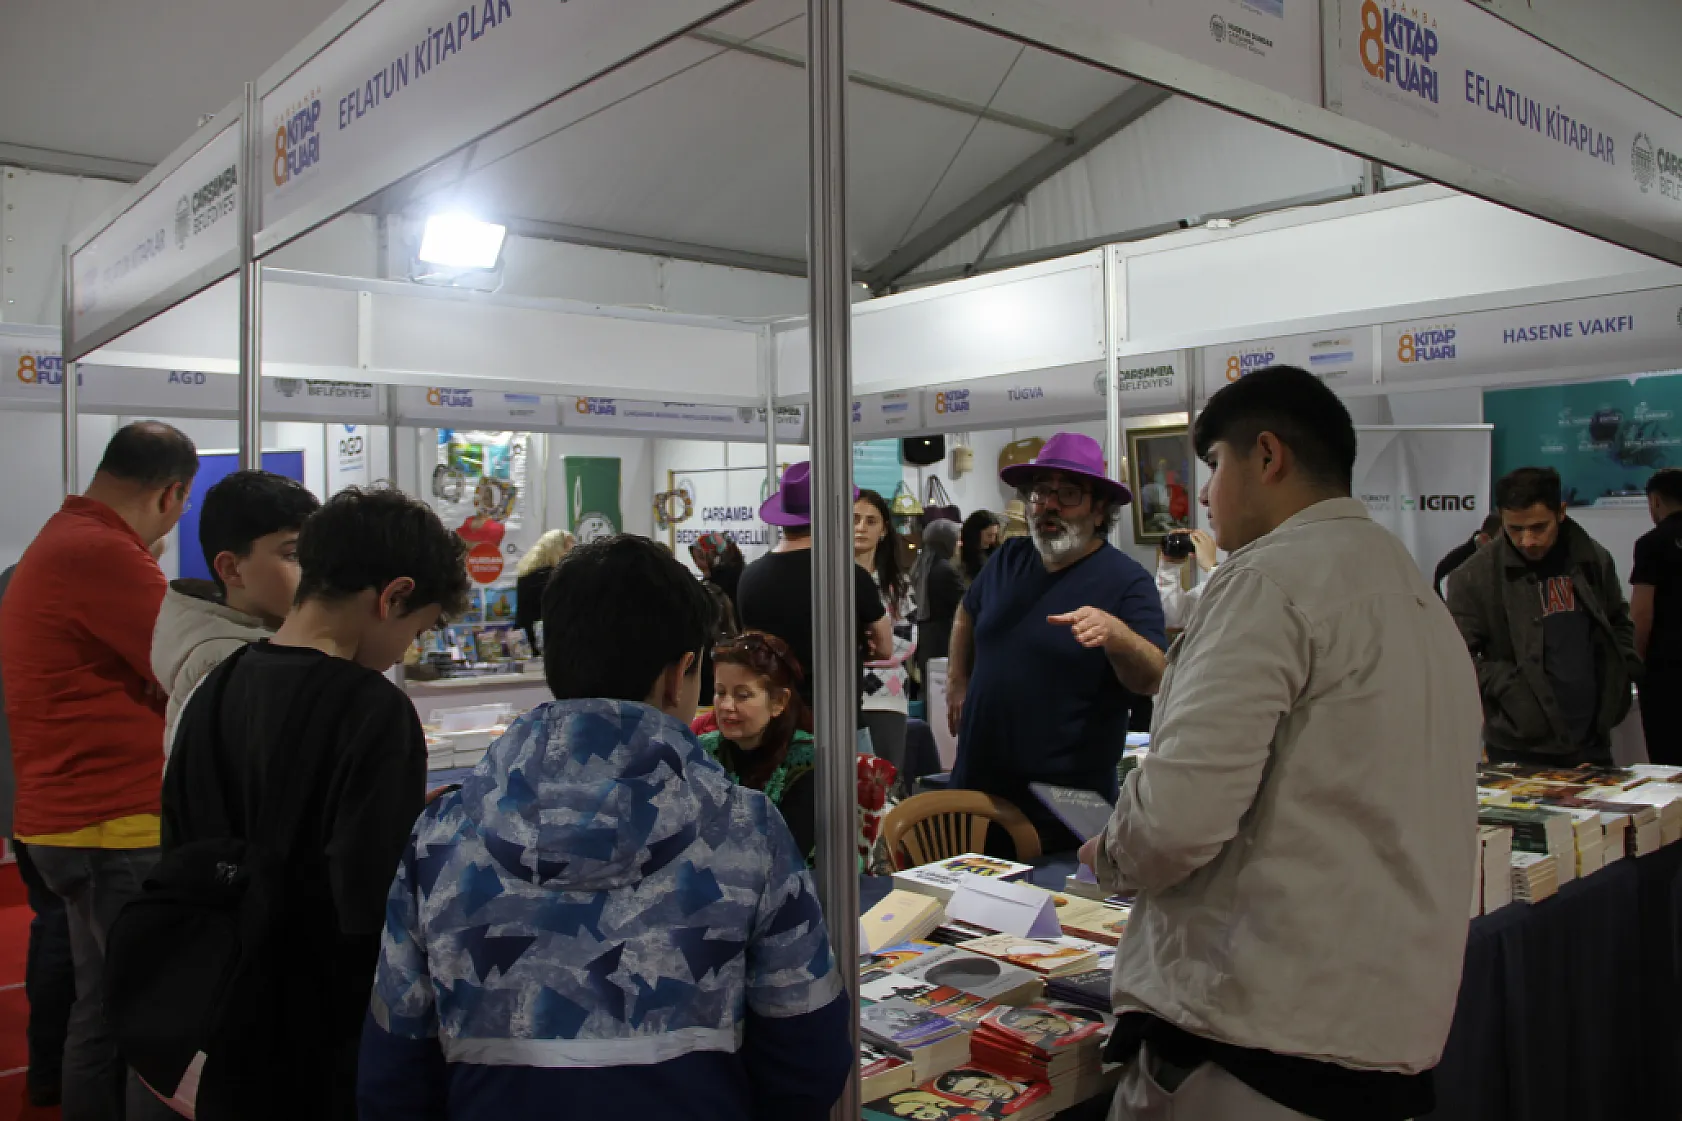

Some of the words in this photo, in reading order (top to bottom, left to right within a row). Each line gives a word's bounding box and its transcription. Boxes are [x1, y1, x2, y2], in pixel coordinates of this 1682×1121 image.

[1383, 7, 1438, 62] KİTAP
[338, 52, 409, 130] EFLATUN
[1384, 48, 1438, 104] FUARI
[287, 100, 321, 150] KİTAP
[1465, 69, 1541, 133] EFLATUN
[1546, 104, 1616, 165] KİTAPLAR
[287, 132, 320, 181] FUARI
[1415, 345, 1456, 362] FUARI
[1503, 321, 1573, 344] HASENE
[1578, 314, 1634, 336] VAKFI
[167, 370, 206, 385] AGD
[702, 505, 755, 526] ÇARŞAMBA
[1419, 494, 1475, 511] IGMG
